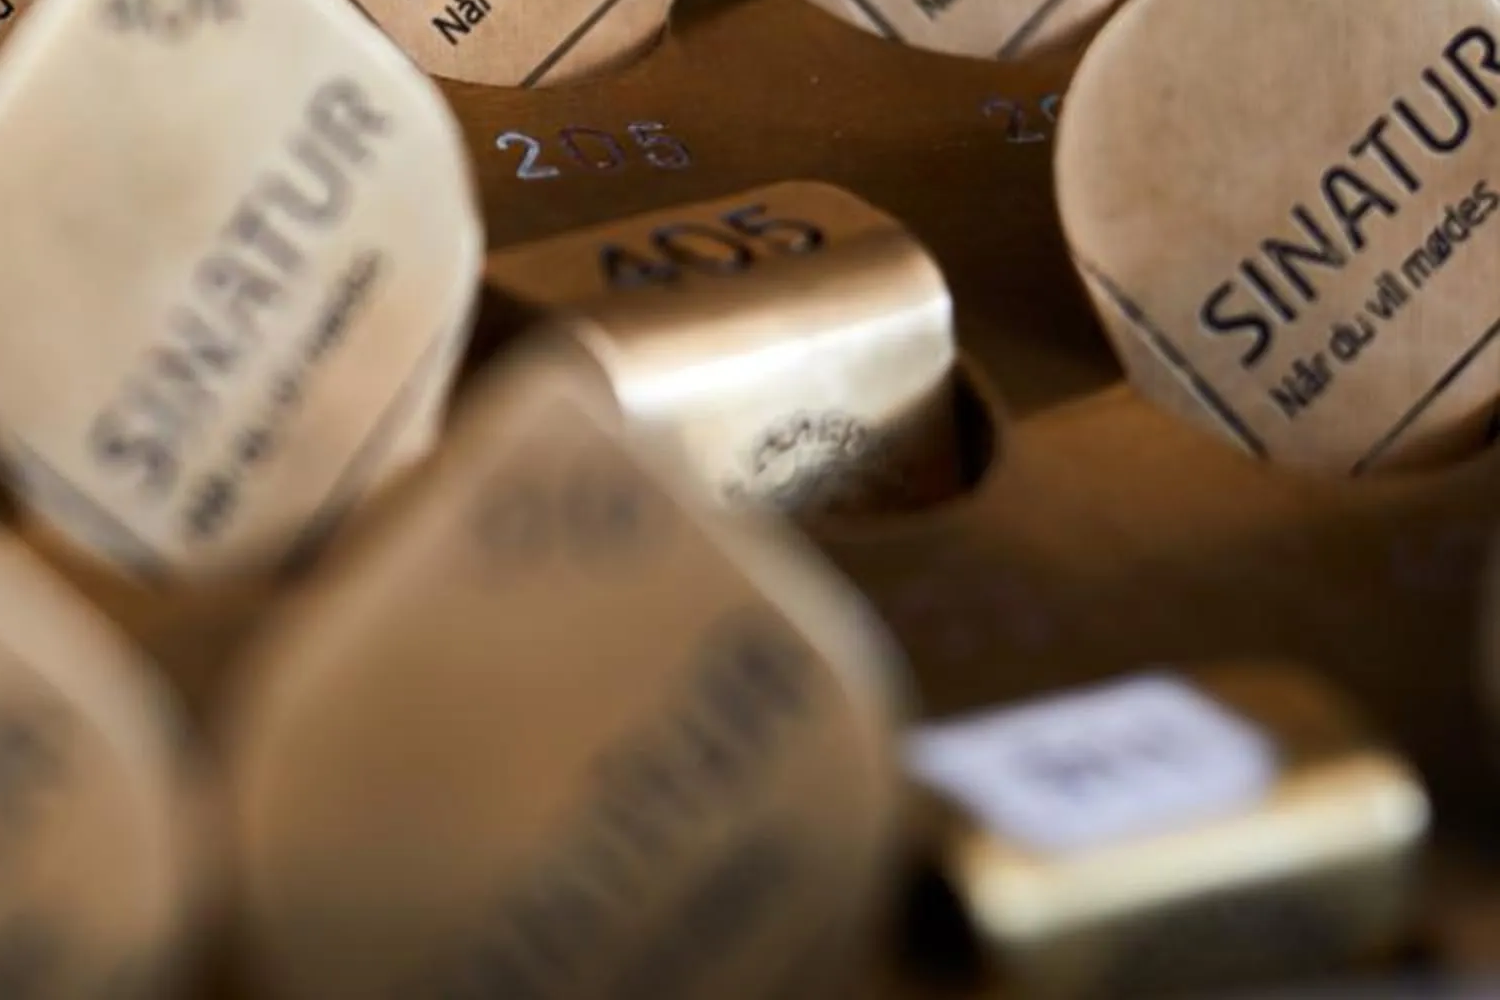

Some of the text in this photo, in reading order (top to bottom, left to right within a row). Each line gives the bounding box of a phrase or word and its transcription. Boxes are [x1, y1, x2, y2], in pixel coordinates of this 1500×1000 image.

[496, 120, 692, 180] 205
[1200, 26, 1500, 370] SINATUR
[1329, 314, 1377, 362] du
[1365, 269, 1410, 320] vil
[1401, 179, 1500, 290] mødes
[90, 75, 393, 494] SINATUR
